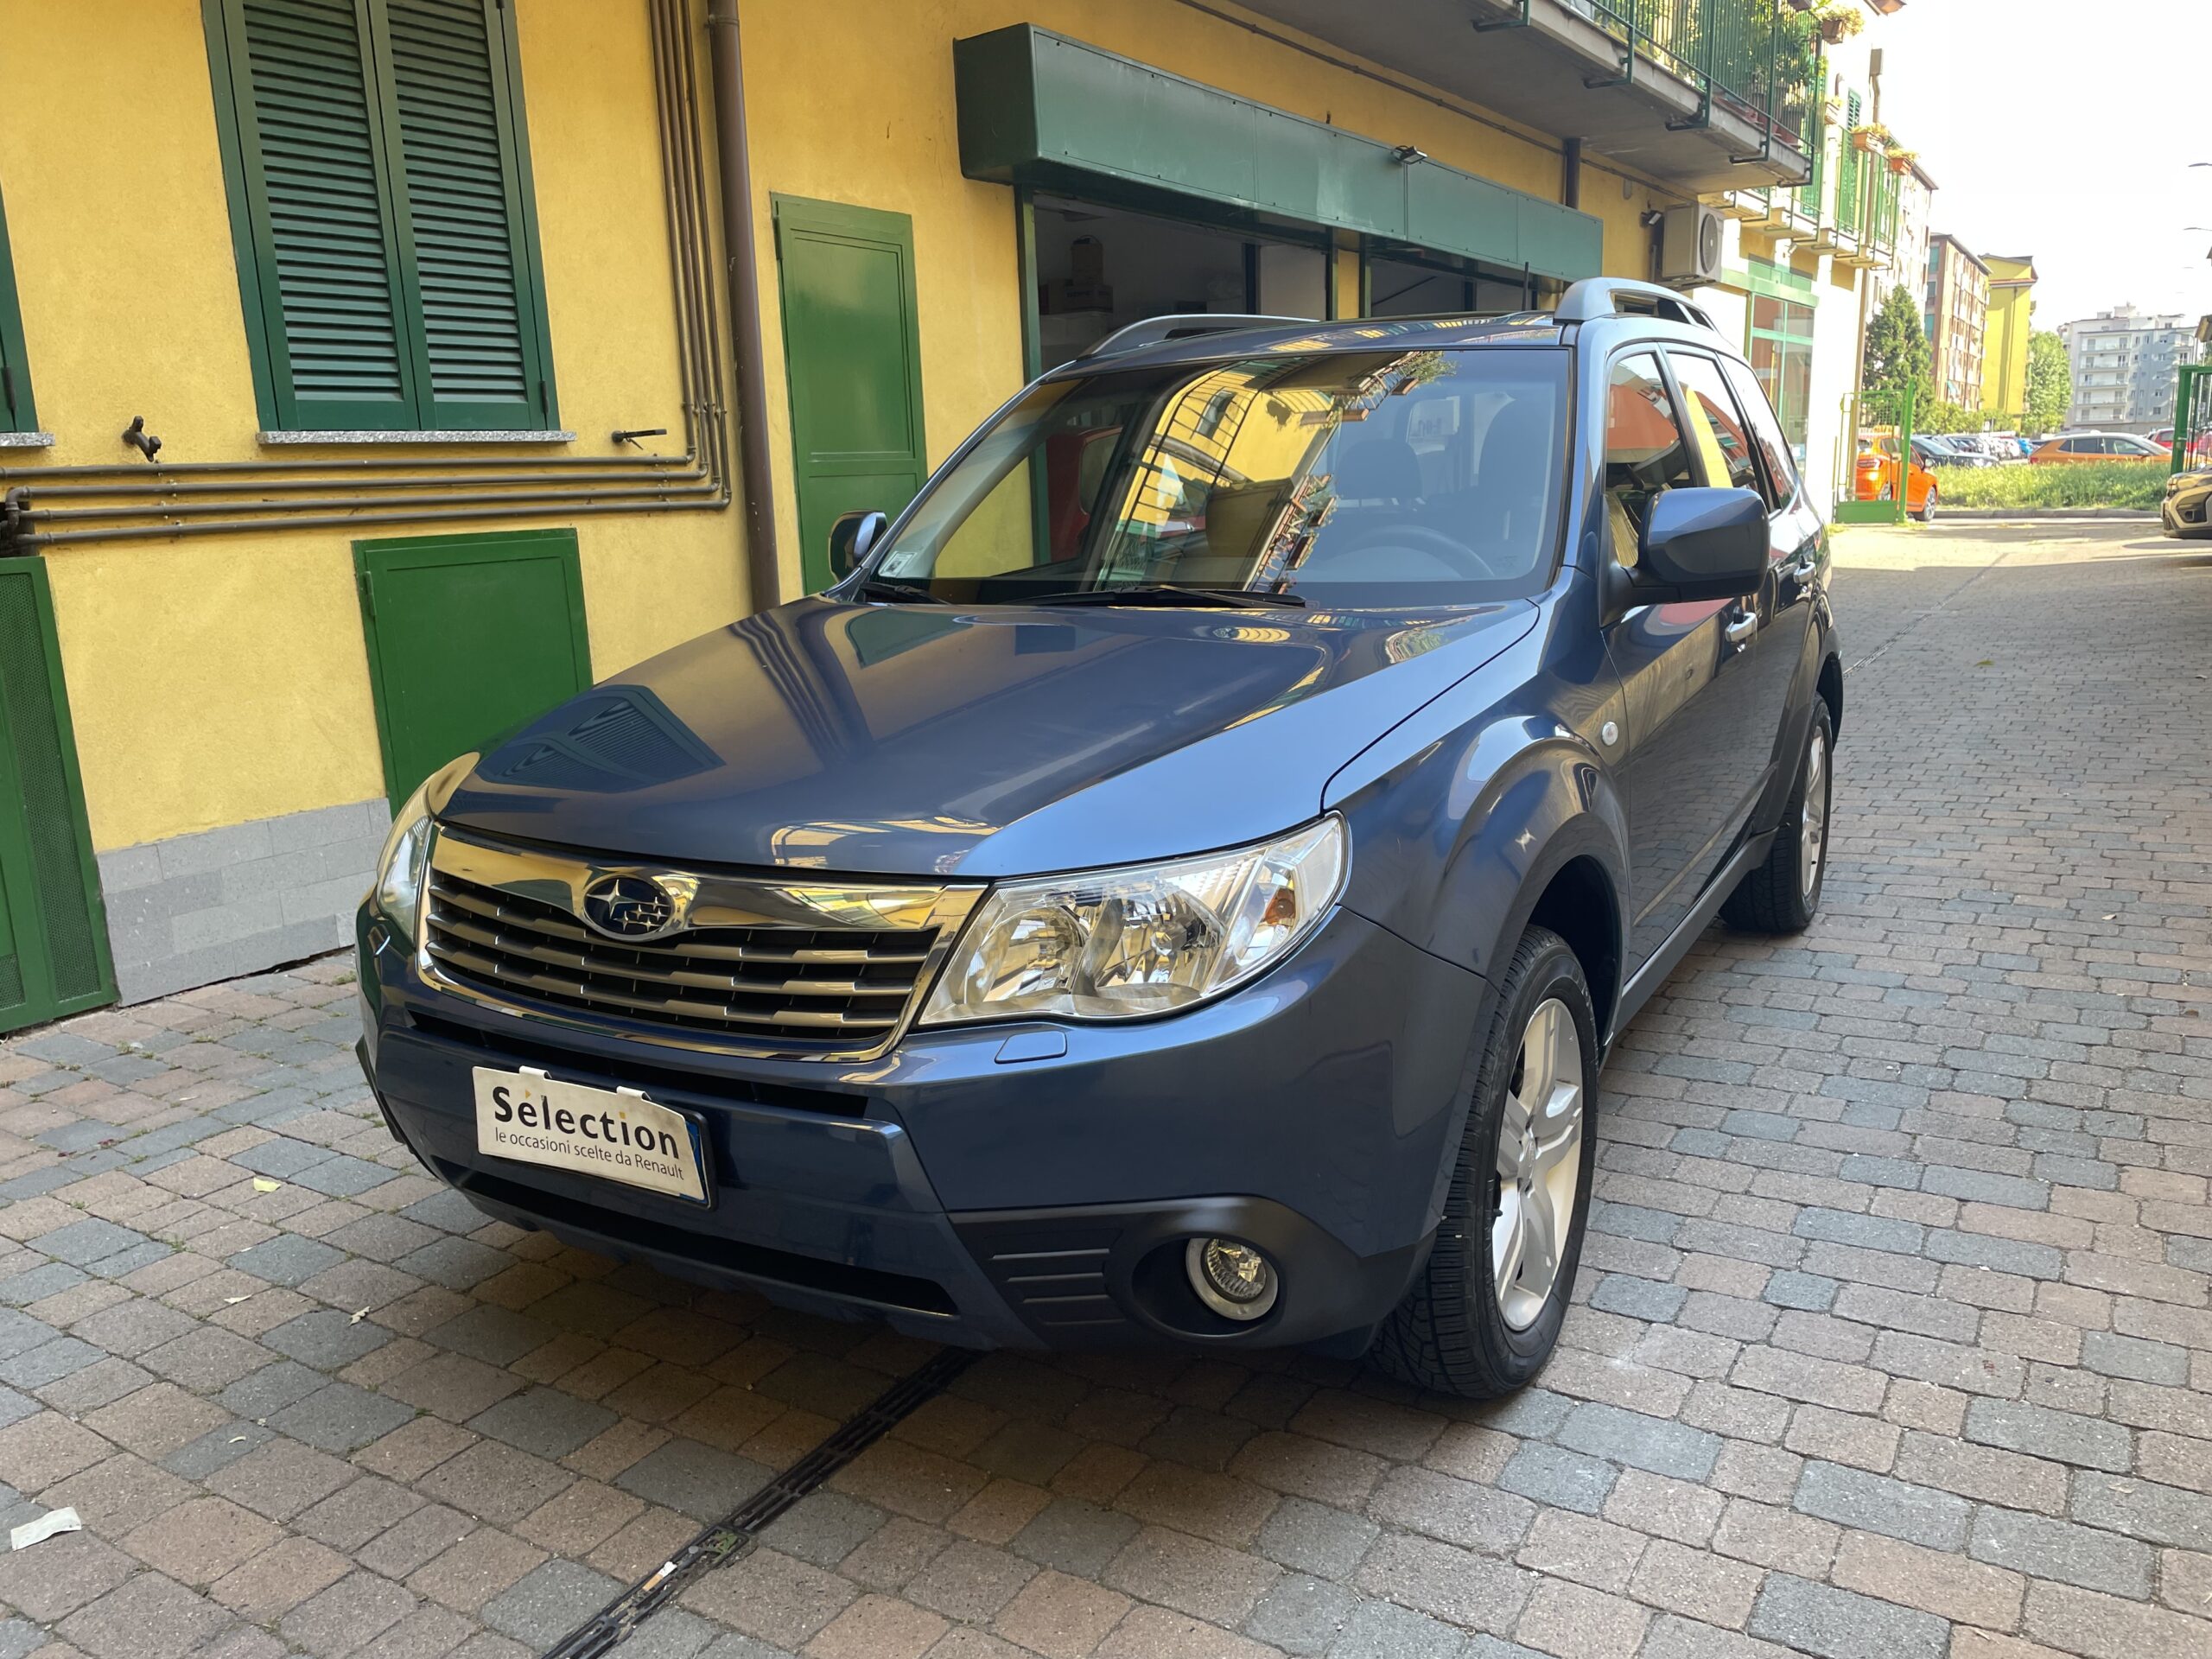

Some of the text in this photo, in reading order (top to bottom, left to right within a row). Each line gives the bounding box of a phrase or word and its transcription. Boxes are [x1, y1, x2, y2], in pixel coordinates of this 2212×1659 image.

[495, 1126, 684, 1180] le occasioni scelte da Renault
